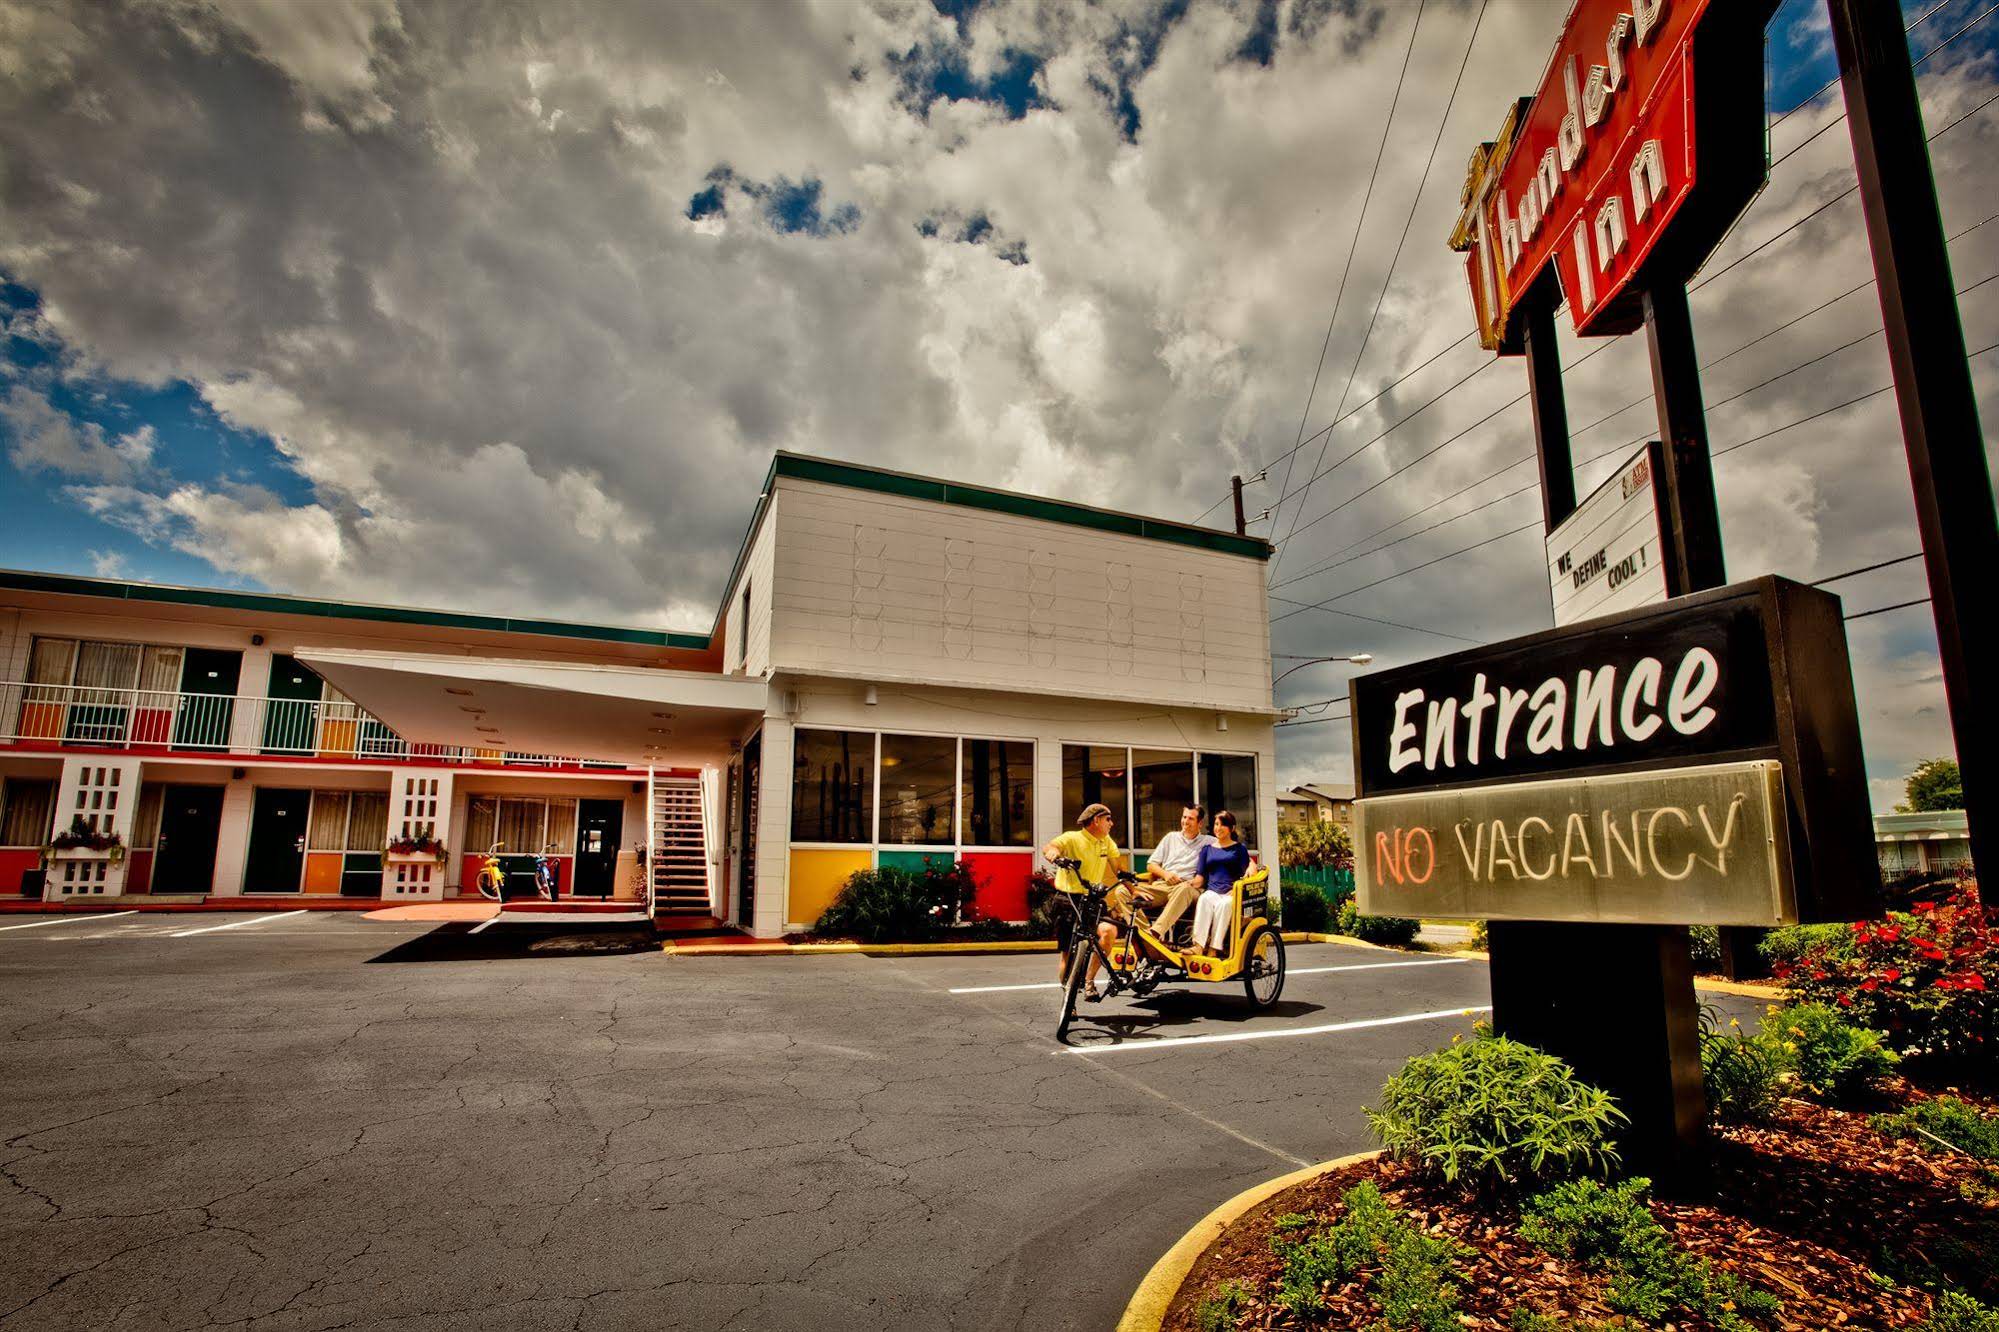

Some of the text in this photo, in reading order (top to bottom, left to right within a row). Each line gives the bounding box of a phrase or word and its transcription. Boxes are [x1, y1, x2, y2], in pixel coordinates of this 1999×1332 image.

[1573, 139, 1667, 315] Inn
[1558, 551, 1572, 576] WE
[1573, 549, 1607, 589] DEFINE
[1388, 646, 1719, 774] Entrance
[1376, 800, 1745, 886] NO VACANCY
